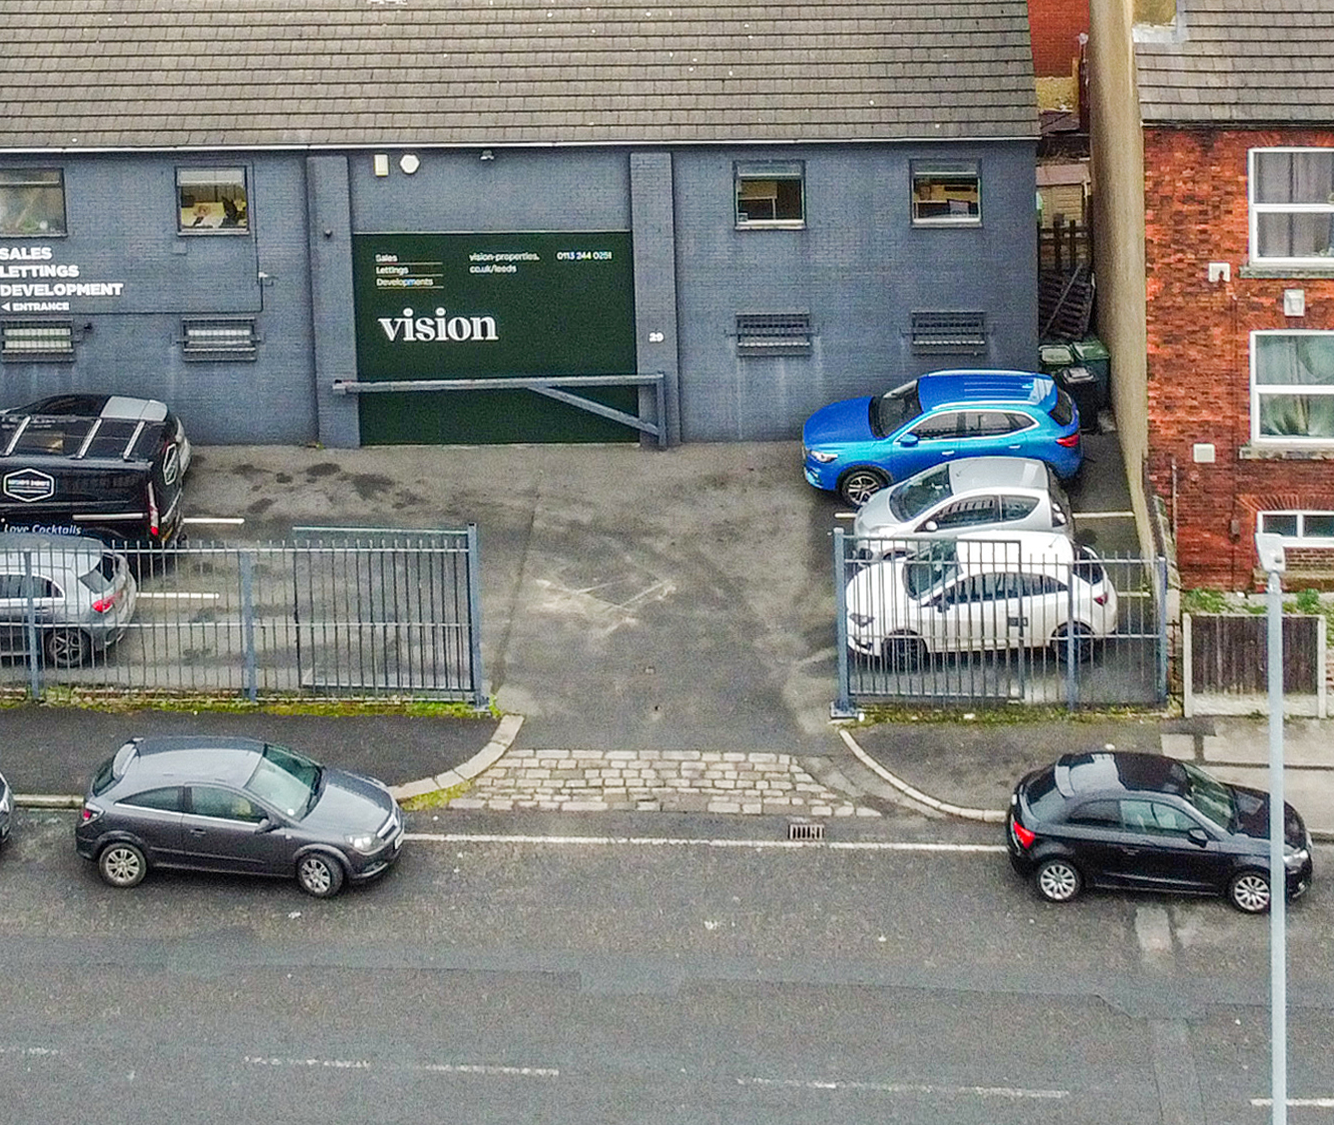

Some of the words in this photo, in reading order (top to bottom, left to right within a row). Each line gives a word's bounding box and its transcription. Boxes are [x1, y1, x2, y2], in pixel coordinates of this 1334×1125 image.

[375, 254, 398, 262] Sales
[375, 266, 409, 275] Lettings
[0, 283, 124, 297] DEVELOPMENT
[12, 302, 70, 312] ENTRANCE
[378, 307, 499, 342] vision
[4, 523, 29, 534] Love
[32, 524, 82, 535] Cocktails
